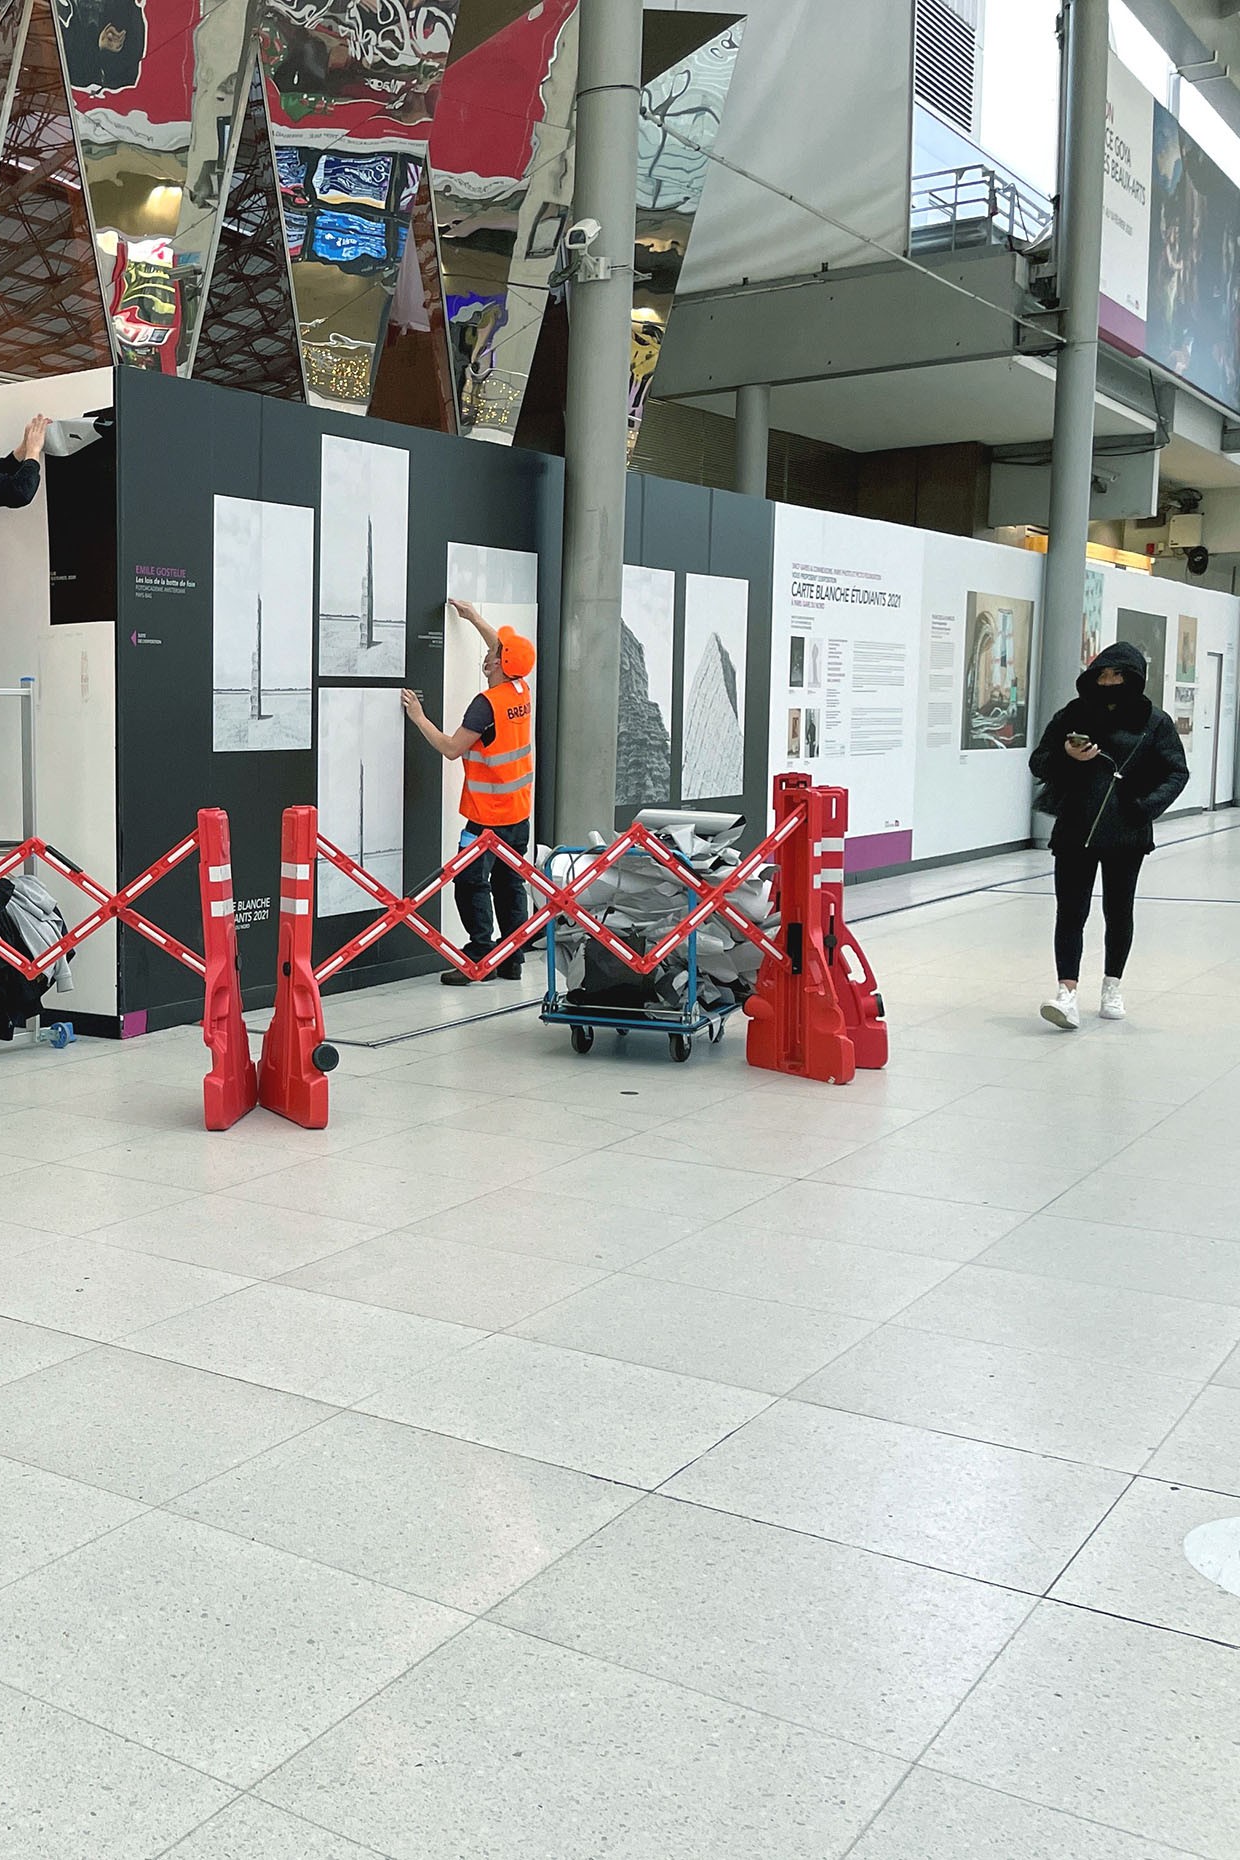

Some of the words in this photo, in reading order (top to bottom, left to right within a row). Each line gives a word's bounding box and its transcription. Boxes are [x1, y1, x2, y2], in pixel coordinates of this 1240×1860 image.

[1115, 136, 1132, 168] GOYA
[135, 565, 156, 576] EMILE
[791, 581, 815, 599] CARTE
[815, 584, 850, 603] BLANCHE
[851, 585, 887, 607] ÉTUDIANTS
[887, 593, 902, 608] 2021
[237, 897, 271, 911] BLANCHE
[234, 911, 252, 923] ANTS
[253, 909, 269, 921] 2021
